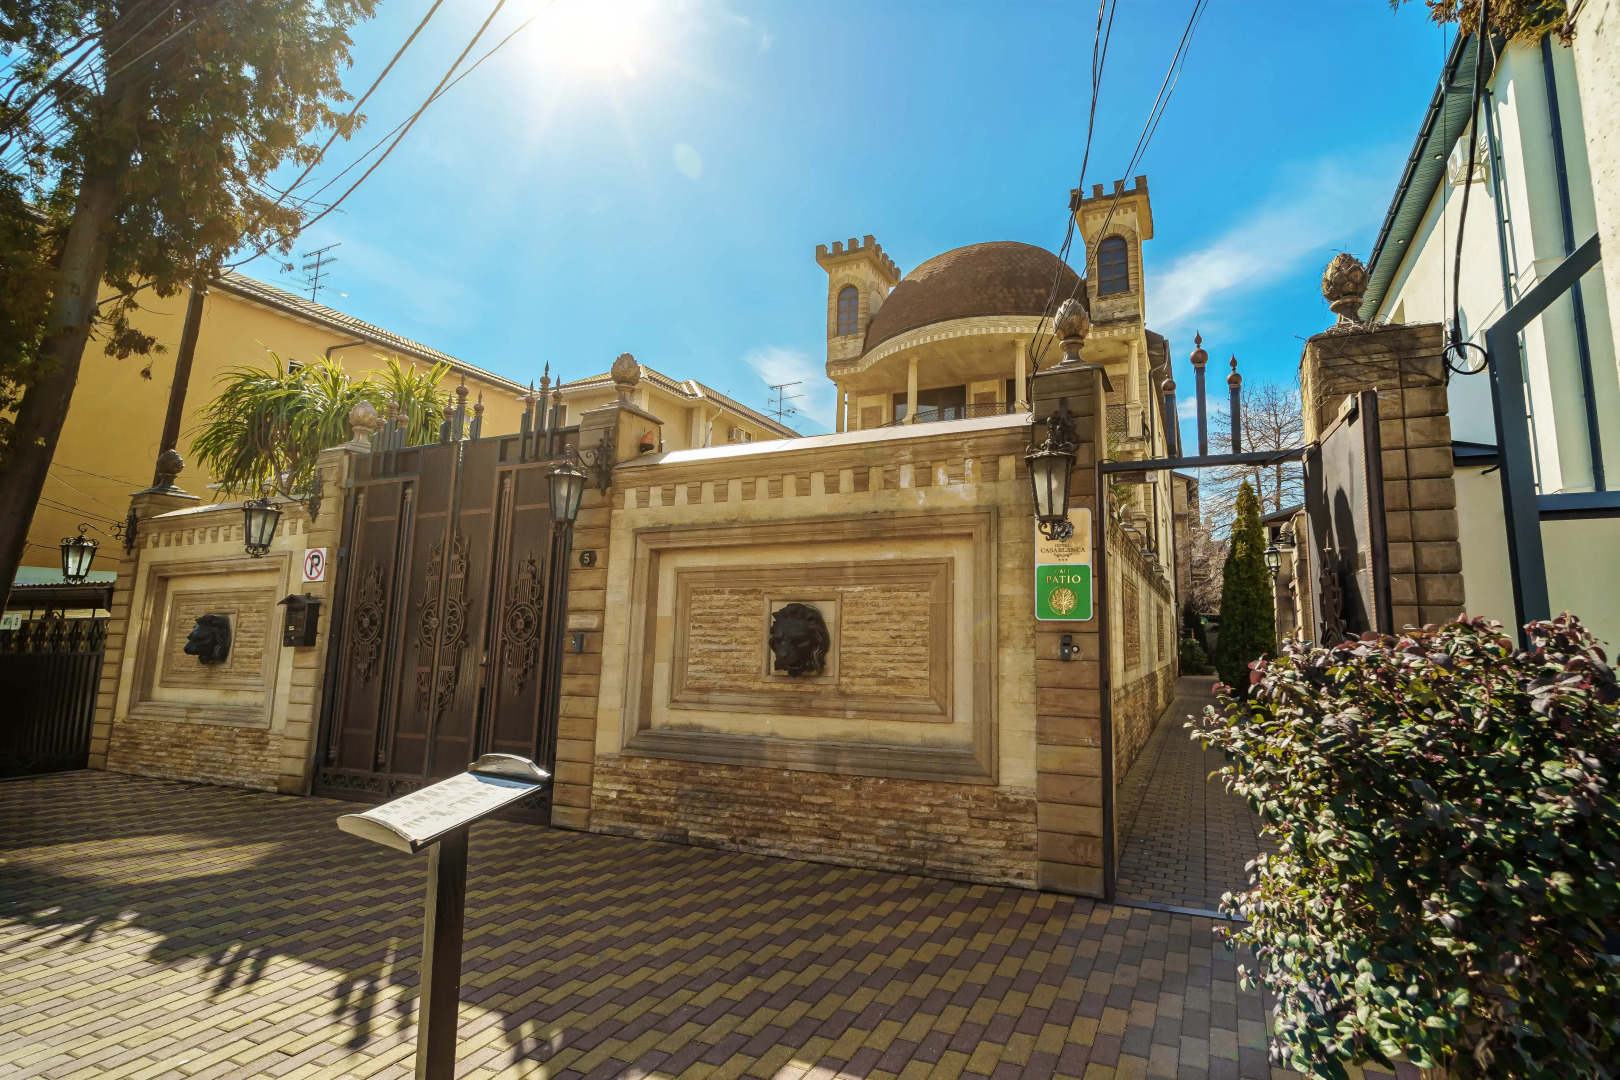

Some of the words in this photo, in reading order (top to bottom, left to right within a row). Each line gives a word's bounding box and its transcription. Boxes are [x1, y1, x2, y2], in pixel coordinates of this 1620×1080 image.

[584, 553, 590, 564] 5
[310, 555, 321, 575] P
[1046, 574, 1082, 584] PATIO
